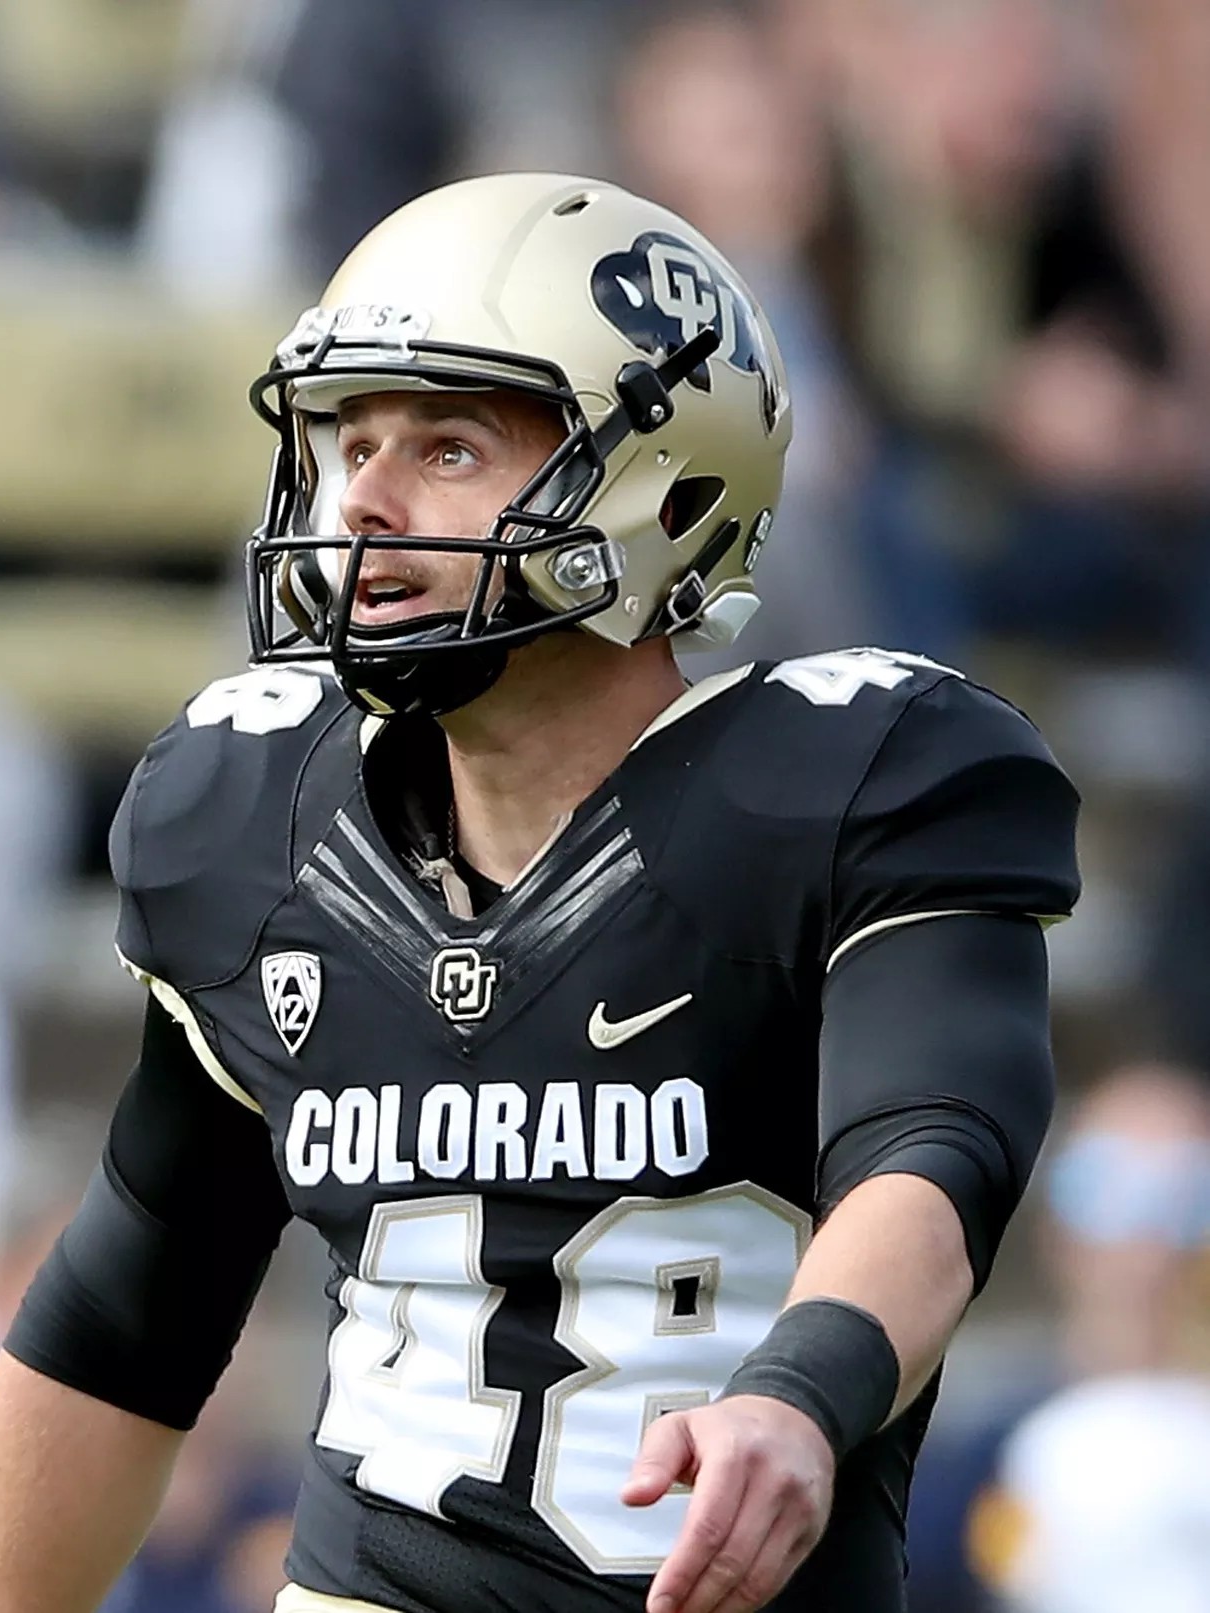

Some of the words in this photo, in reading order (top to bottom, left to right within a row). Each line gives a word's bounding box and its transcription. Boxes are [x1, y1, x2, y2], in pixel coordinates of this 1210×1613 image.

[278, 993, 306, 1032] 12
[430, 947, 497, 1020] CU
[285, 1077, 709, 1187] COLORADO
[315, 1179, 813, 1574] 48
